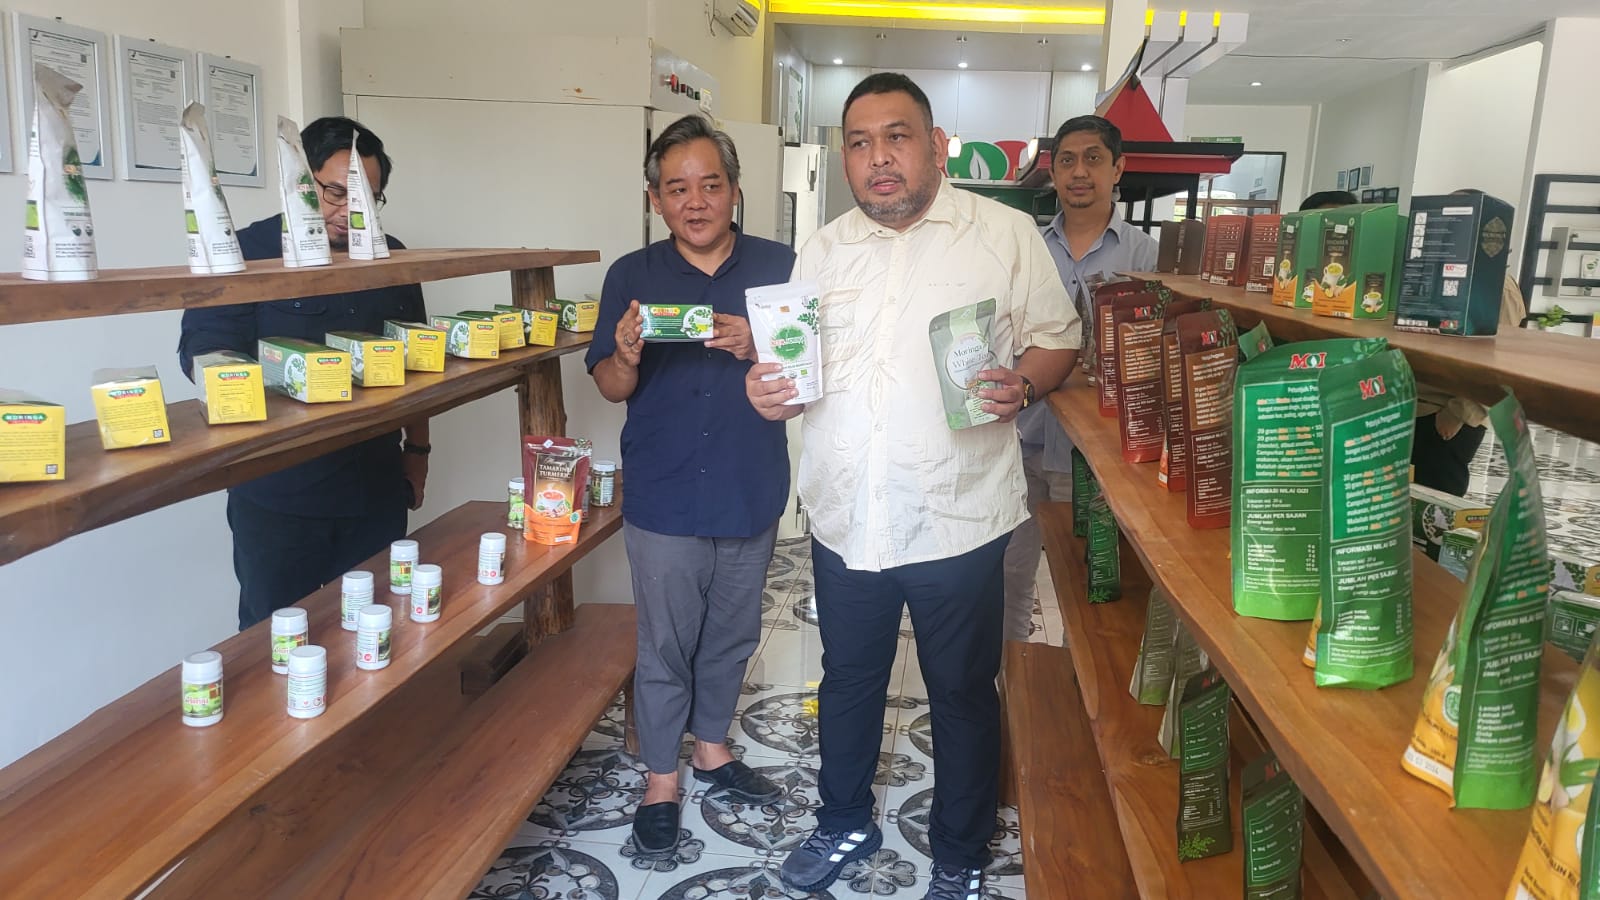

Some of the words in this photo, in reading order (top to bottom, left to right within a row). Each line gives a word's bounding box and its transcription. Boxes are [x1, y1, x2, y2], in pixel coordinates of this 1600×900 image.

[954, 344, 982, 358] Moringa
[1288, 352, 1327, 370] MOI
[1360, 376, 1386, 400] MOI
[1336, 544, 1372, 556] INFORMASI
[1338, 575, 1366, 585] JUMLAH
